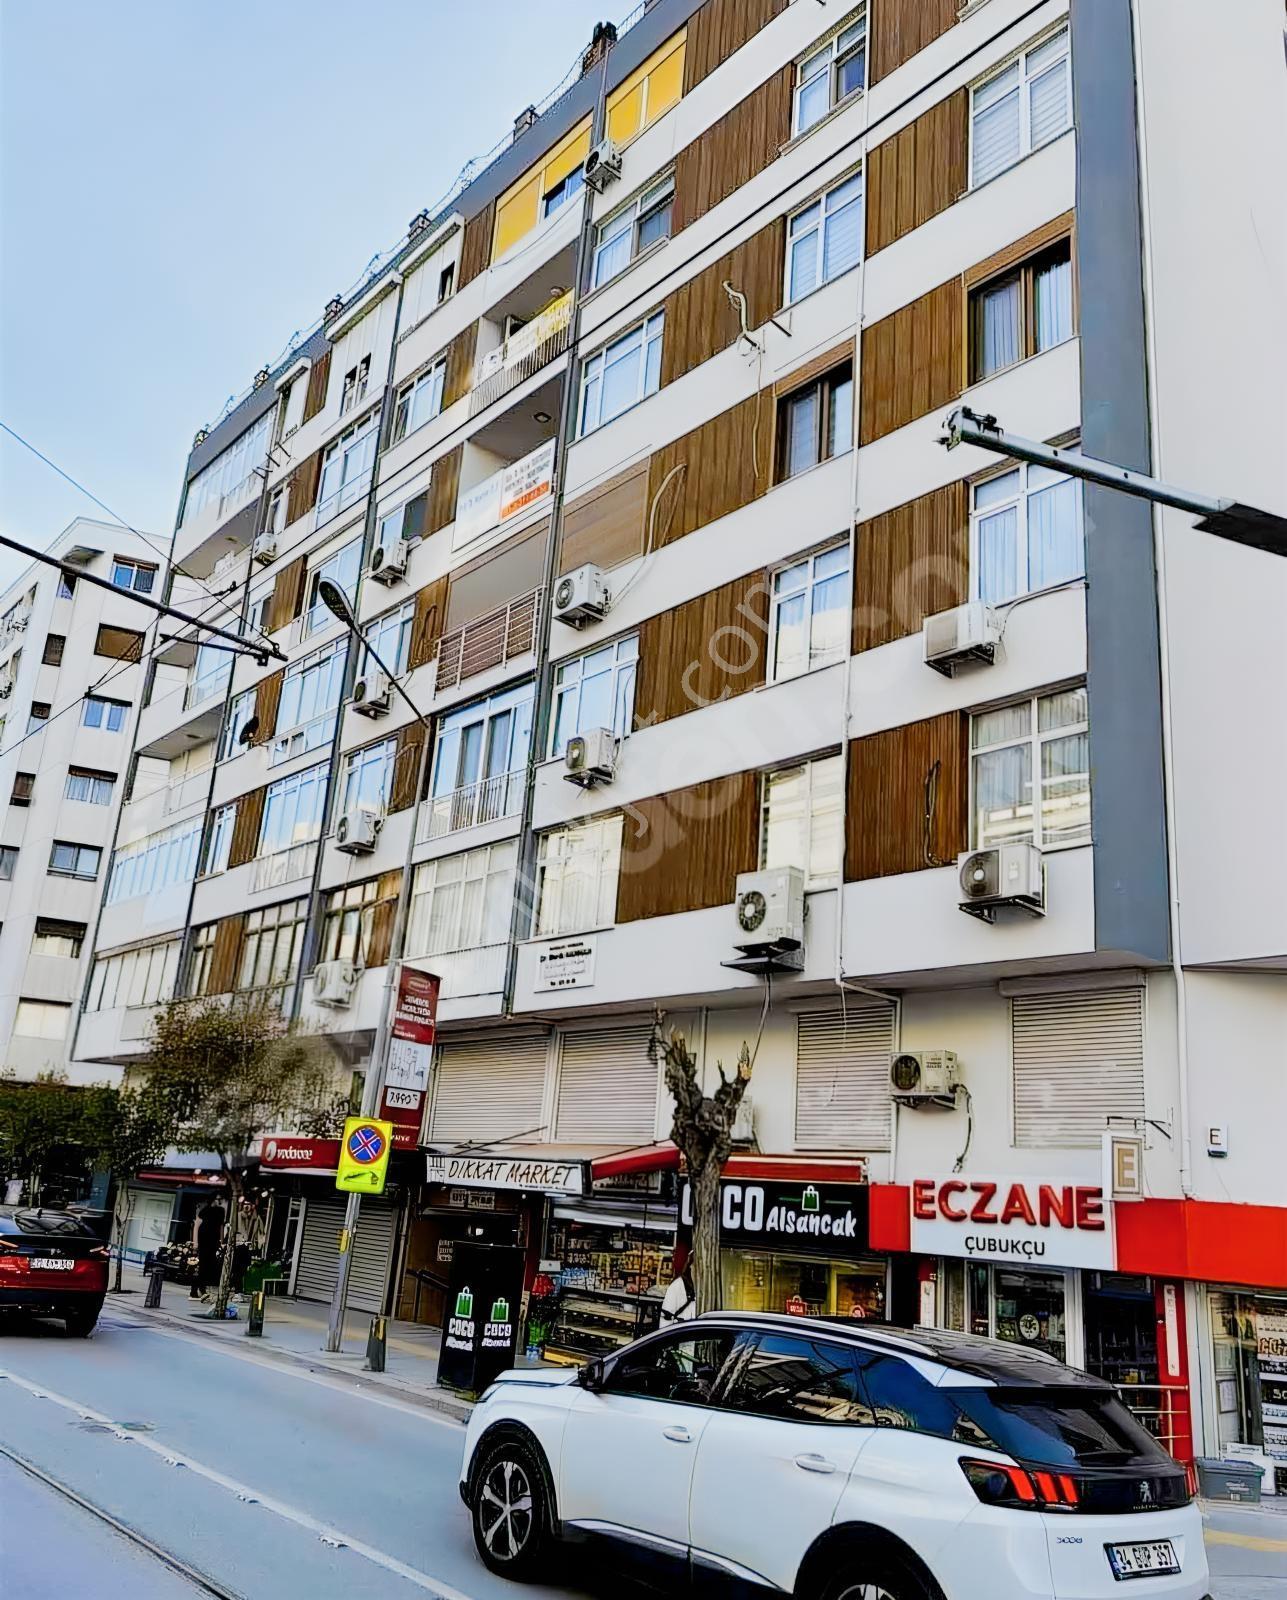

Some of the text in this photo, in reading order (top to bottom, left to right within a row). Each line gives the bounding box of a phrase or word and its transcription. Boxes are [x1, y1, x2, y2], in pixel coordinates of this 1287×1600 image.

[1208, 1127, 1222, 1146] E
[448, 1160, 508, 1182] DIKKAT
[505, 1163, 580, 1187] MARKET
[1117, 1147, 1138, 1188] E
[682, 1183, 858, 1238] CCO Alsancak
[912, 1179, 1105, 1231] ECZANE
[964, 1236, 1046, 1260] ÇUBUKÇU
[448, 1317, 475, 1338] COCO
[484, 1323, 512, 1337] COCO
